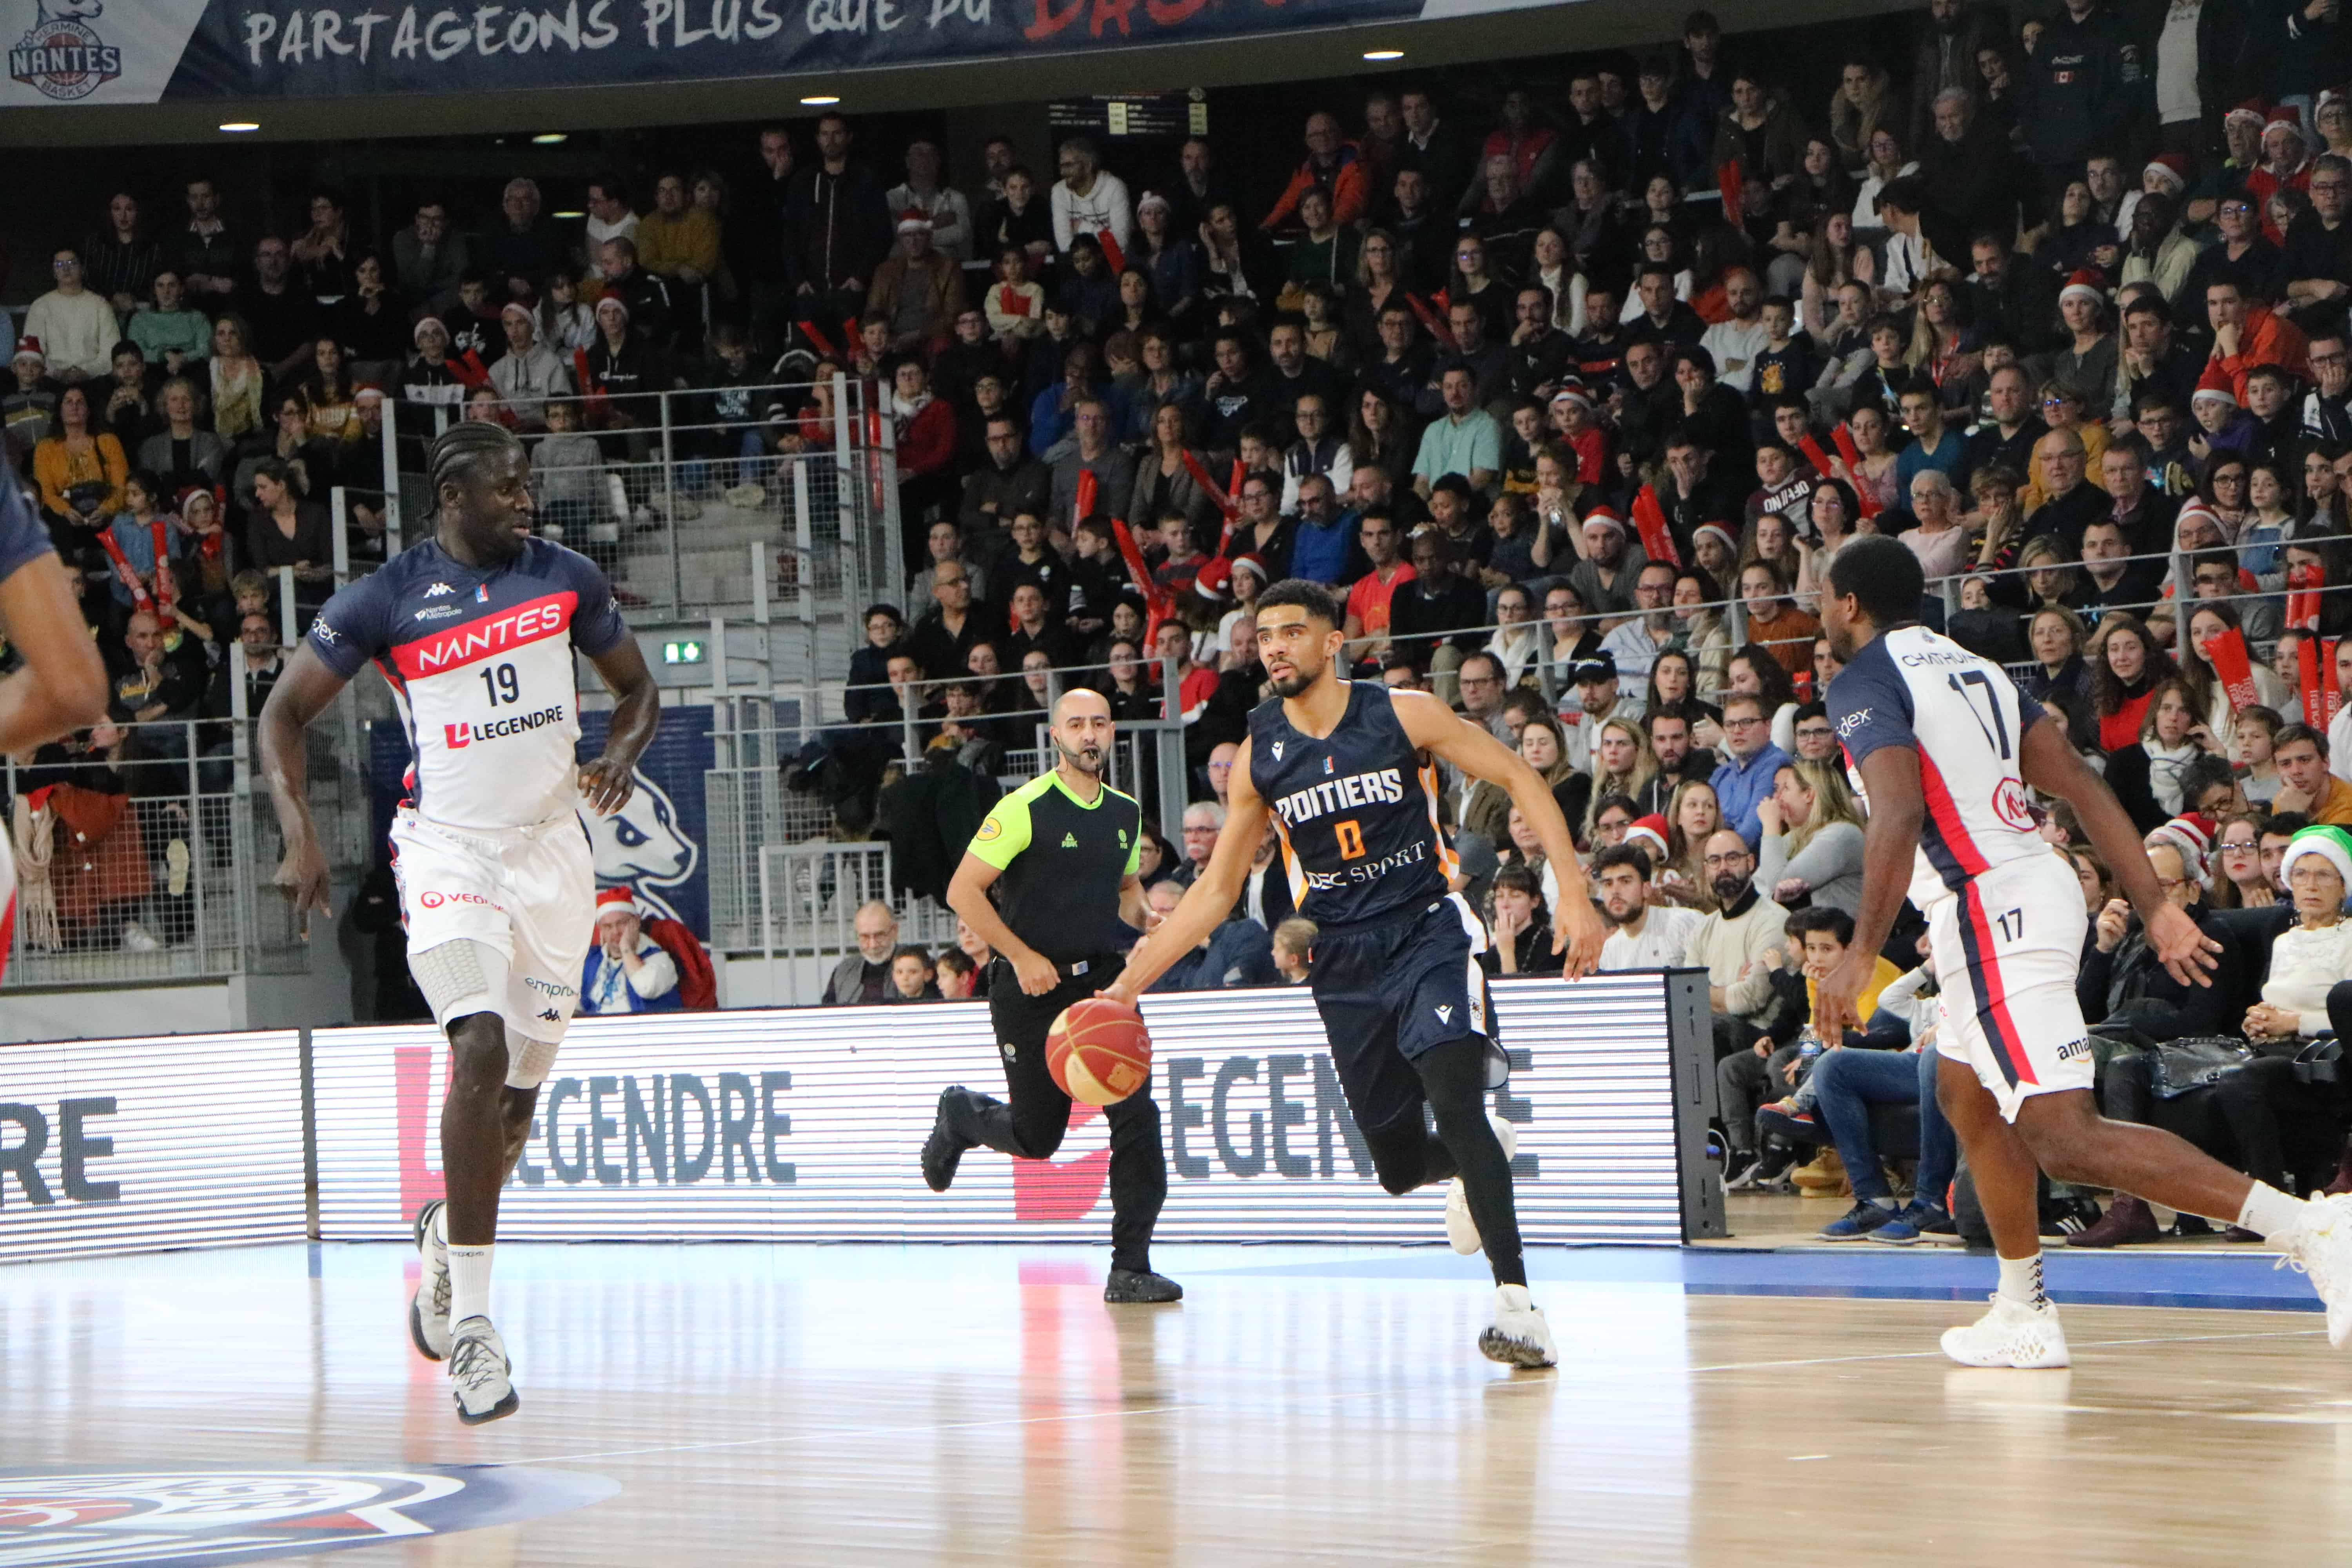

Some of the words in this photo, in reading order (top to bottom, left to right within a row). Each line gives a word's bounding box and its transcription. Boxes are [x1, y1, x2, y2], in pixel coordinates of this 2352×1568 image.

[36, 23, 89, 42] HERMINE
[243, 0, 619, 67] PARTAGEONS
[641, 0, 783, 49] PLUS
[12, 47, 118, 76] NANTES
[40, 79, 92, 97] BASKET
[426, 604, 451, 613] Nantes
[419, 604, 561, 671] NANTES
[480, 663, 519, 707] 19
[474, 706, 563, 741] LEGENDRE
[1948, 670, 2012, 760] 17
[1276, 768, 1403, 828] POITIERS
[1334, 820, 1366, 860] 0
[1350, 840, 1425, 882] SPORT
[1997, 907, 2023, 942] 17
[0, 1097, 121, 1206] RE
